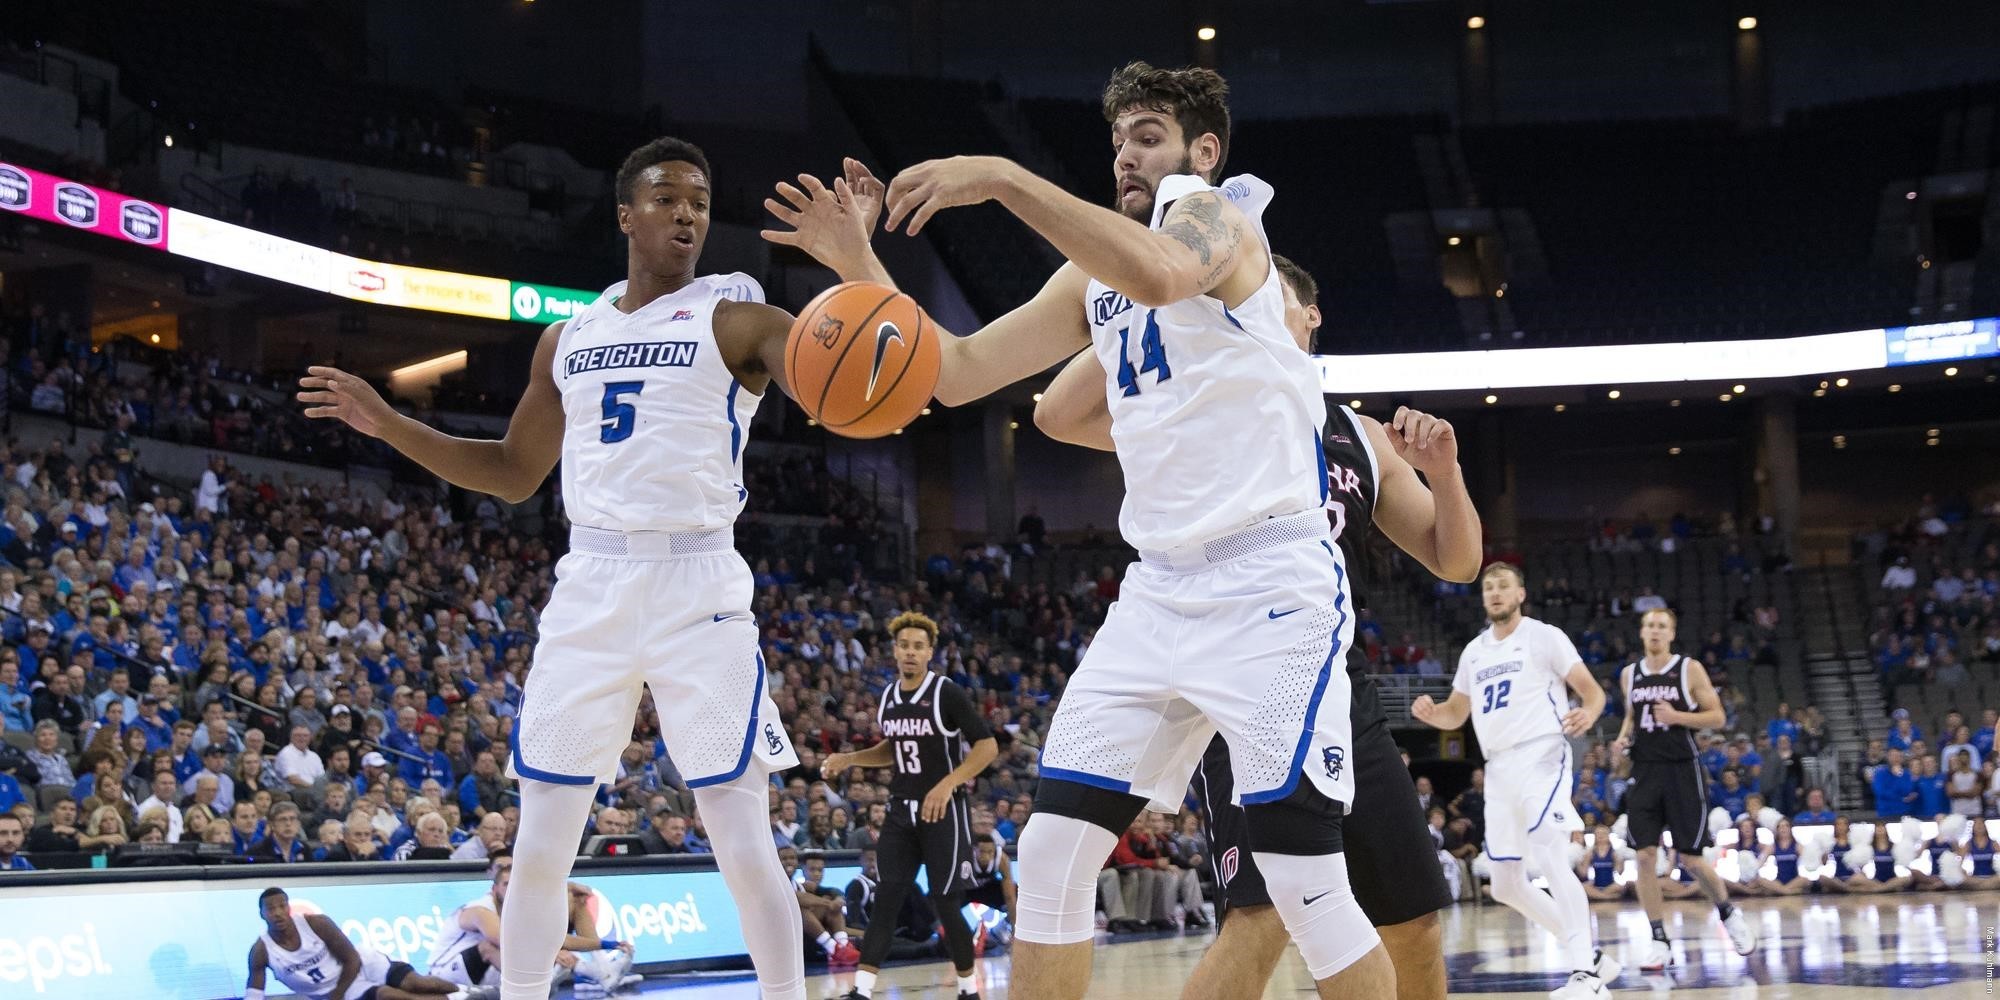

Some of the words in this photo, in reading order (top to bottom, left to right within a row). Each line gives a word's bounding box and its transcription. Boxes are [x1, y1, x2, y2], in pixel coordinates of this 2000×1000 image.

[565, 341, 699, 379] CREIGHTON
[600, 380, 645, 444] 5
[1483, 679, 1512, 713] 32
[1631, 685, 1680, 703] OMAHA
[882, 718, 934, 737] OMAHA
[895, 740, 922, 774] 13
